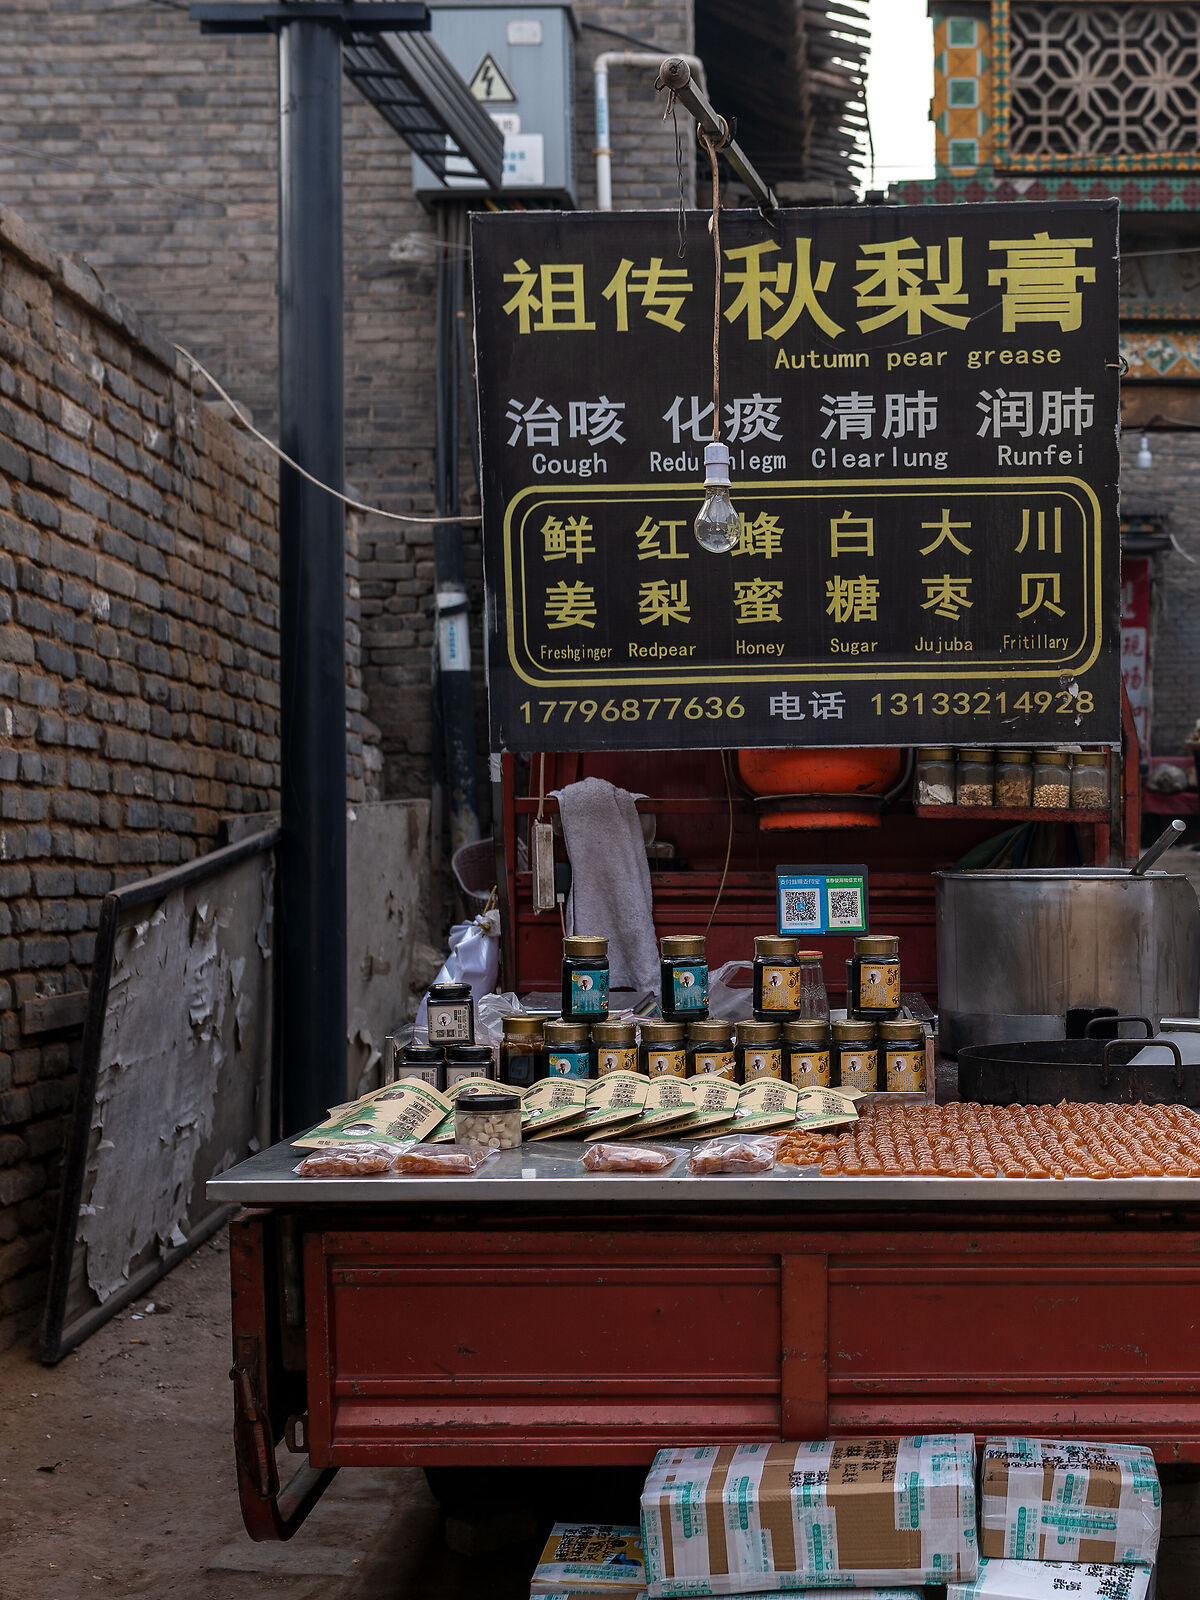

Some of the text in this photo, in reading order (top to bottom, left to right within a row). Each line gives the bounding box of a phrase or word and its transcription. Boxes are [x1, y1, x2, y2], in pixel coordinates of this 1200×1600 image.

[503, 256, 694, 335] 祖传
[723, 231, 1097, 341] 秋梨膏
[774, 348, 1062, 371] Autumn pear grease
[505, 386, 1095, 448] 治咳 化痰 清肺 润肺
[531, 452, 608, 477] Cough
[998, 444, 1085, 468] Runfei
[540, 514, 597, 630] 鲜姜
[635, 515, 692, 626] 红梨
[731, 511, 785, 625] 蜂蜜
[825, 509, 880, 623] 白糖
[919, 508, 973, 621] 大枣
[1014, 507, 1065, 620] 川贝
[540, 634, 1070, 662] Freshginger Redpear Honey Sugar Jujuba Fritillary
[519, 690, 1096, 724] 17796877636 电话 13133214928
